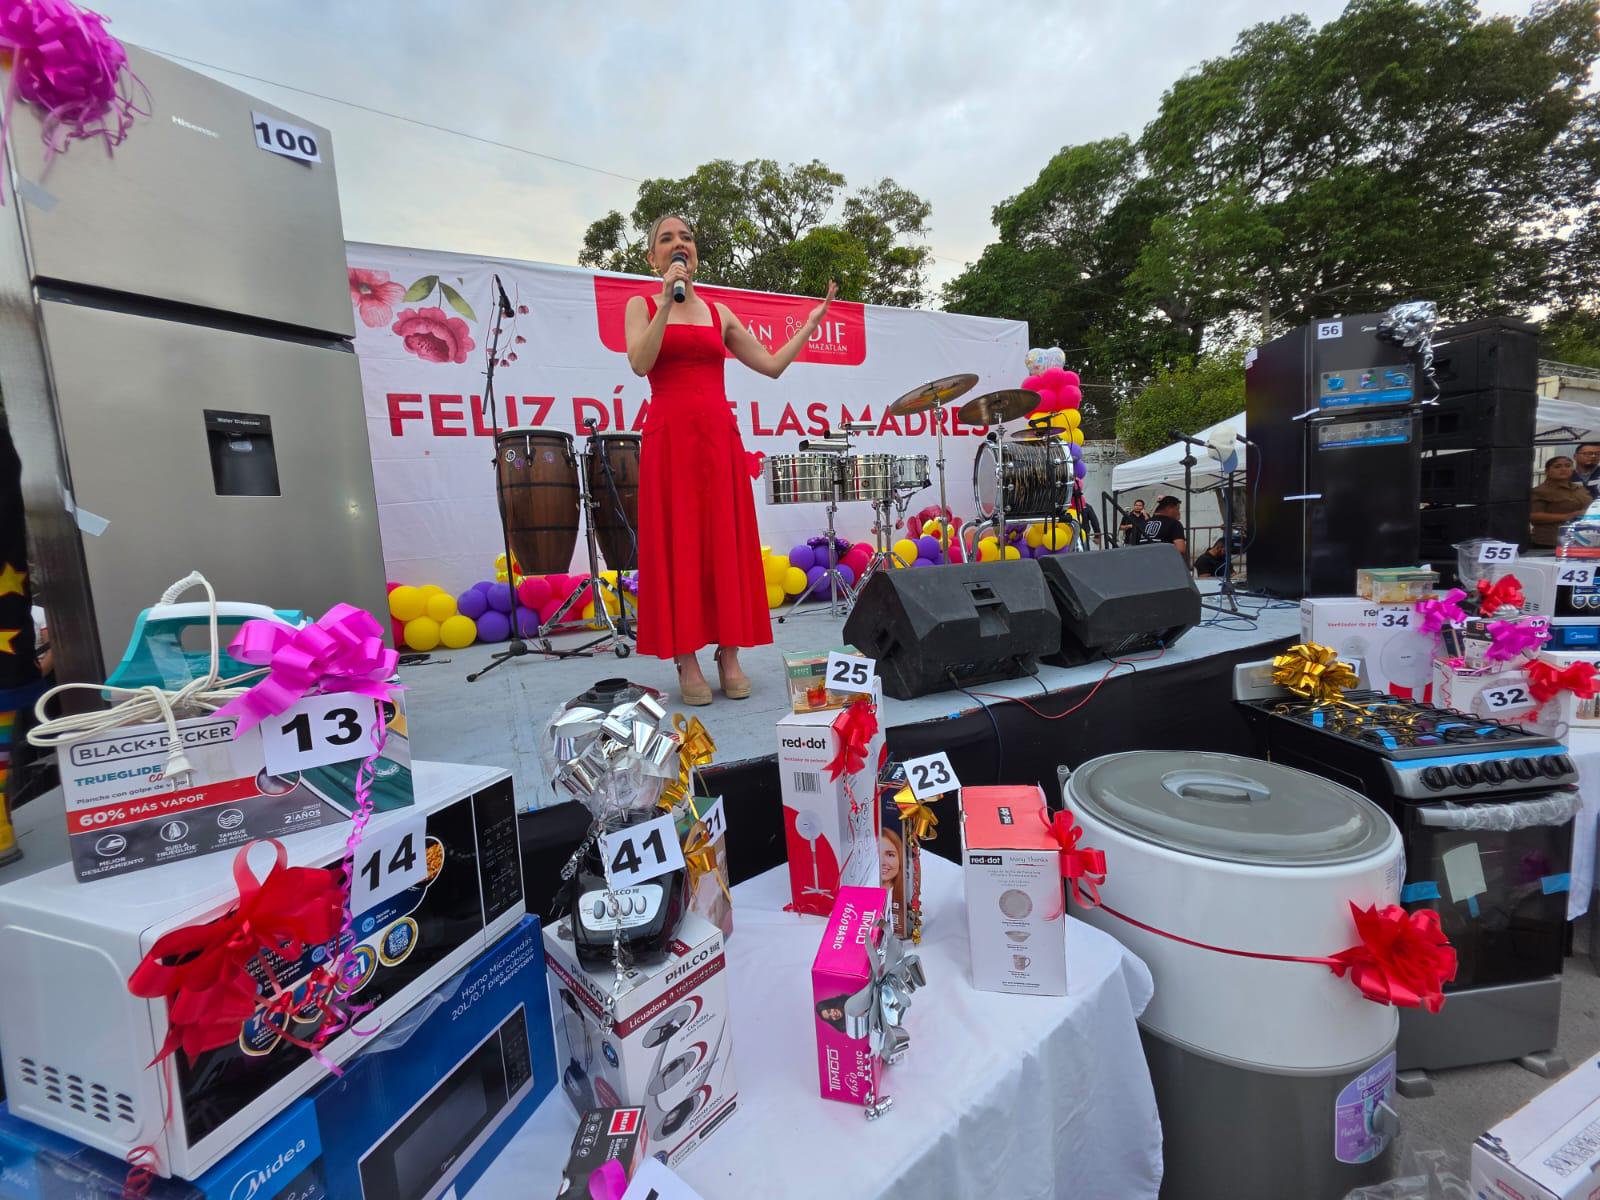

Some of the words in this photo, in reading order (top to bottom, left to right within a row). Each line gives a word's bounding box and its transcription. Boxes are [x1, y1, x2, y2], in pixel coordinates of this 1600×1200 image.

[255, 121, 318, 157] 100
[809, 320, 847, 344] DIF
[1321, 325, 1340, 336] 56
[808, 341, 848, 352] MAZATLÁN
[386, 393, 556, 437] FELIZ
[750, 401, 829, 437] LAS
[841, 403, 990, 437] MADRES
[1484, 547, 1512, 560] 55
[1561, 570, 1589, 583] 43
[1382, 614, 1410, 627] 34
[832, 660, 869, 685] 25
[1489, 688, 1529, 707] 32
[281, 707, 363, 753] 13
[74, 764, 162, 787] TRUEGLIDE
[912, 760, 951, 790] 23
[76, 794, 111, 806] Plancha
[111, 791, 128, 799] con
[129, 787, 153, 797] golpe
[79, 809, 126, 827] 60%
[130, 802, 158, 816] MÁS
[284, 815, 293, 824] 2
[294, 808, 322, 822] AÑOS
[705, 807, 722, 839] 21
[361, 832, 417, 892] 14
[611, 828, 667, 875] 41
[602, 888, 632, 898] PILCO
[832, 924, 850, 951] BASIC
[461, 974, 488, 1000] Horno
[489, 936, 534, 976] Microondas
[665, 950, 709, 985] PHILCO
[487, 971, 505, 991] pies
[571, 963, 604, 1002] PHILCO
[629, 999, 668, 1029] Licuadora
[826, 1047, 840, 1092] TIMCO
[856, 1049, 864, 1078] BASIC
[844, 1072, 859, 1097] 1650
[230, 1139, 306, 1200] Midea
